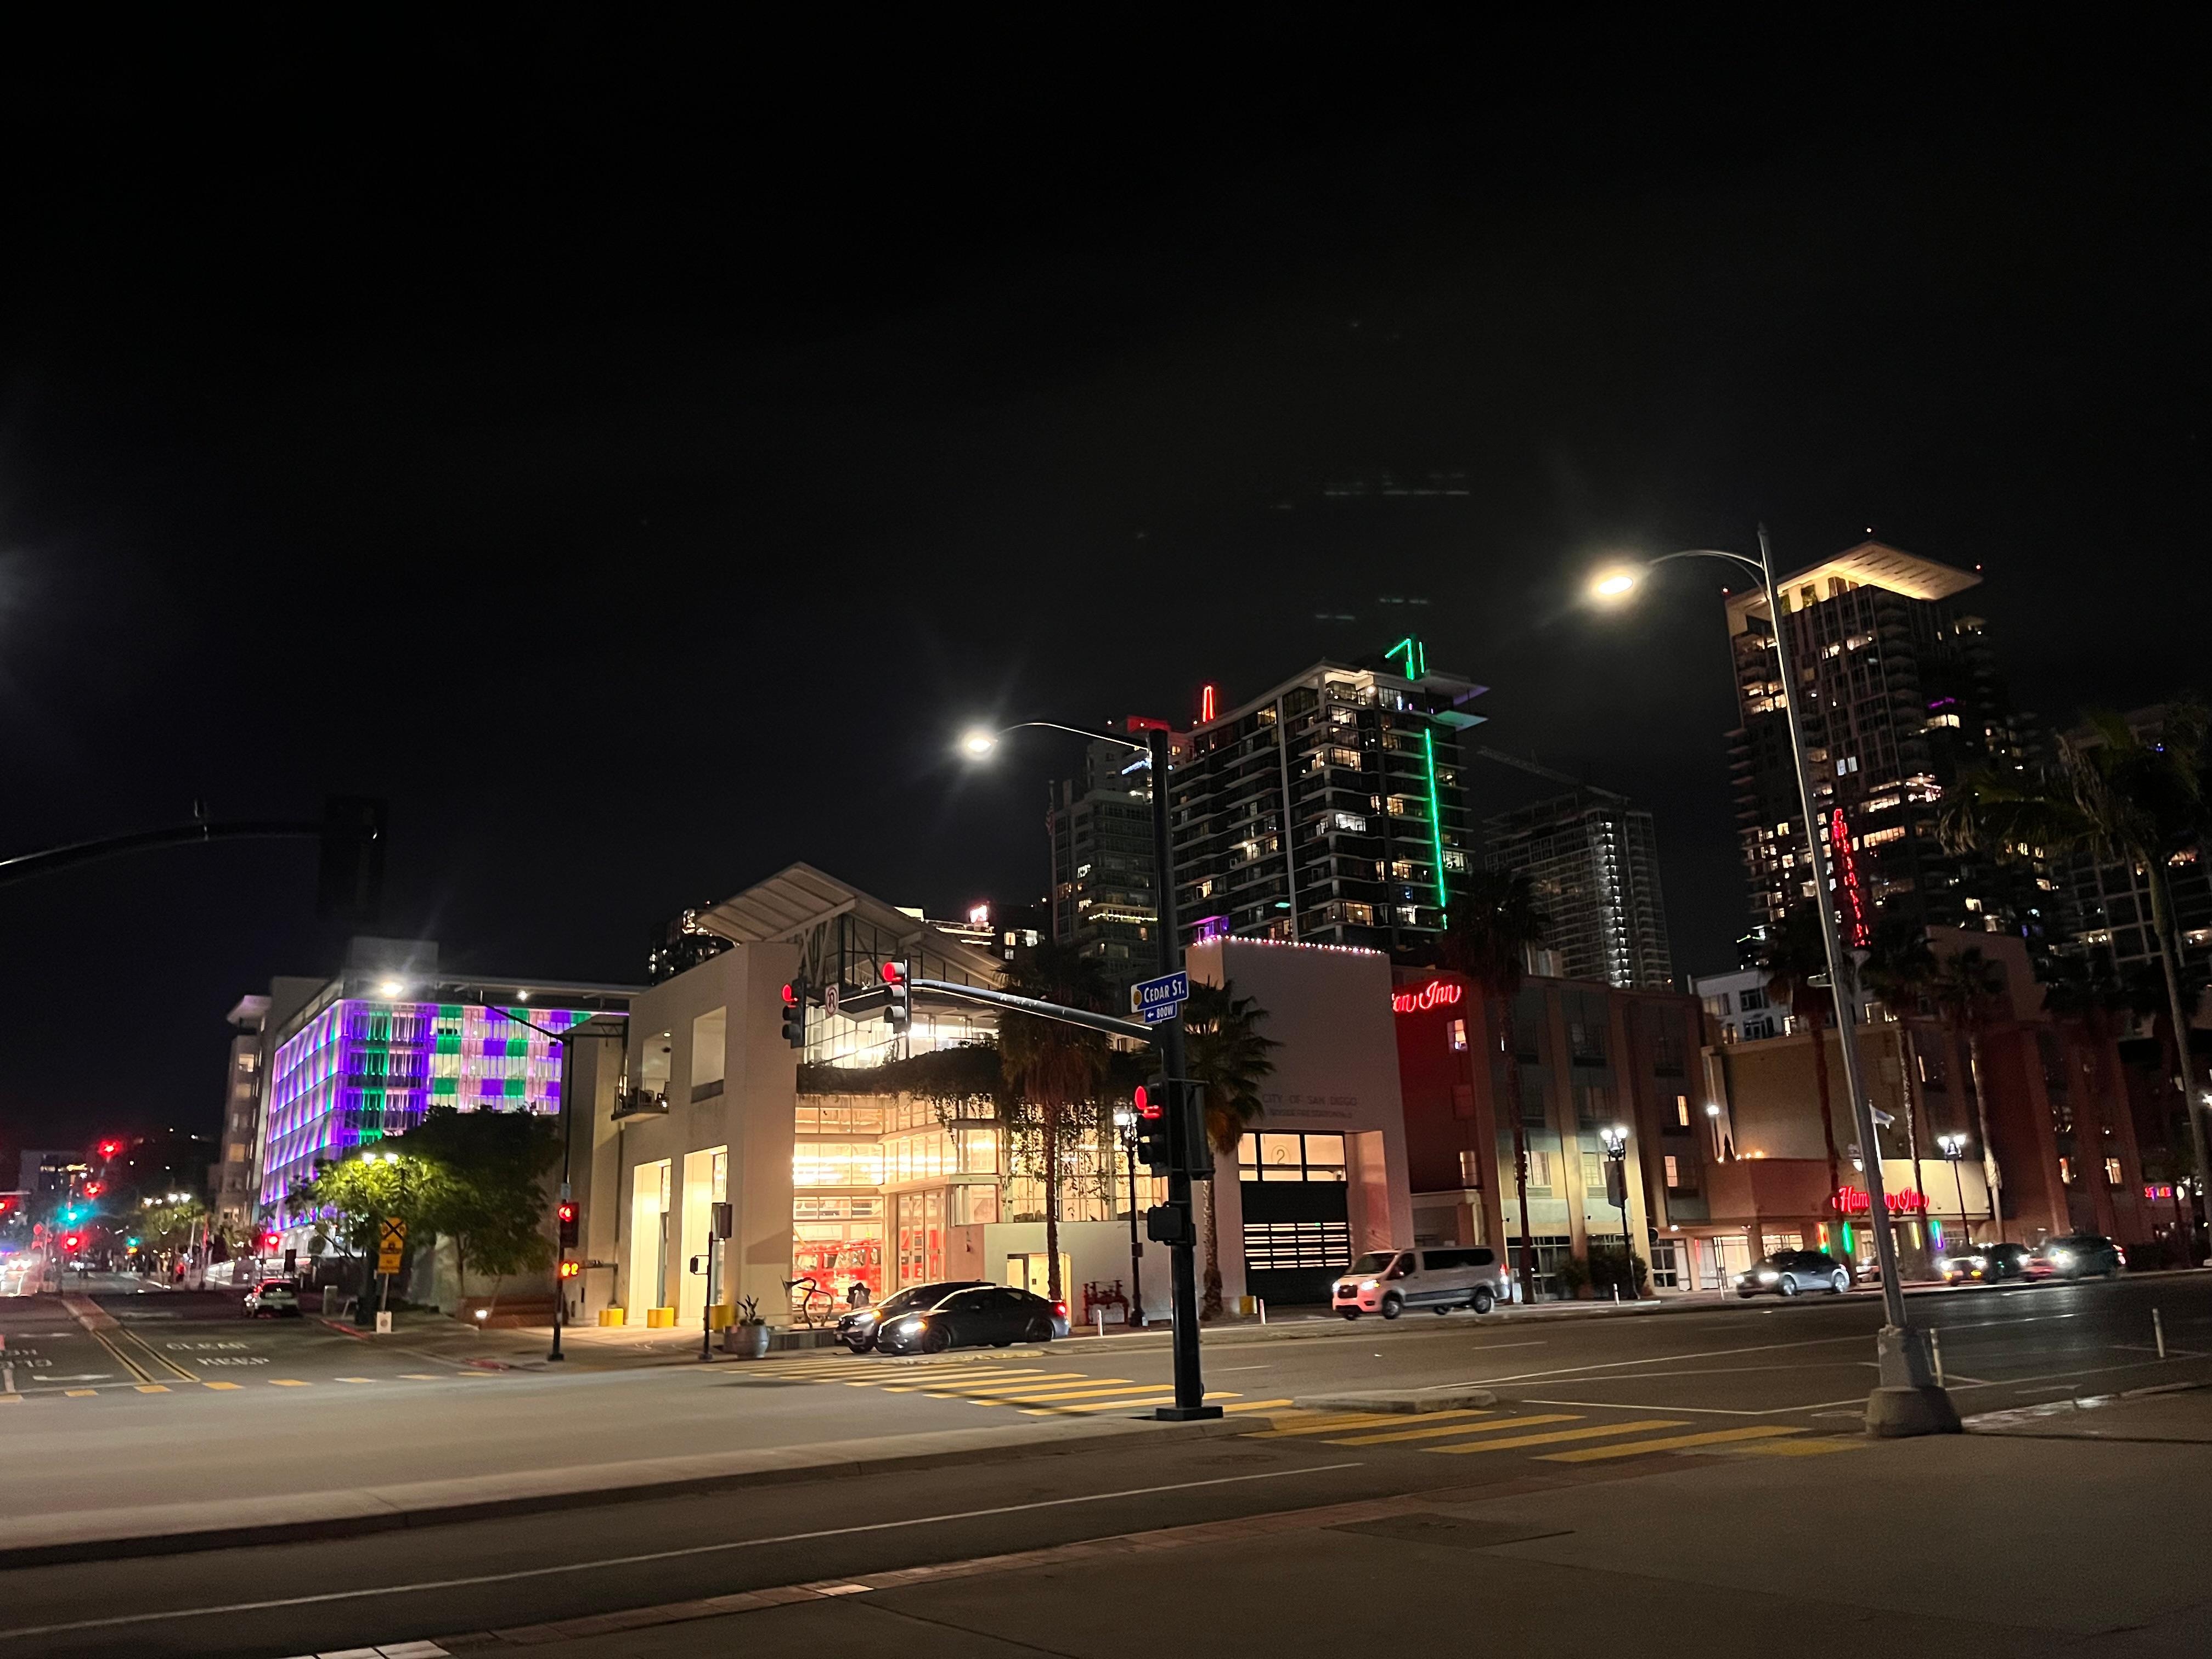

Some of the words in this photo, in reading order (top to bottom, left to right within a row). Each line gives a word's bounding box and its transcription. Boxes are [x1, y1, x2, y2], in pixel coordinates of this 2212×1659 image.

[1144, 985, 1170, 1003] CEDAR
[1172, 979, 1184, 996] ST.
[1392, 994, 1416, 1012] on
[1419, 981, 1462, 1009] Inn
[1156, 1005, 1173, 1018] 800W
[1262, 1094, 1282, 1103] CITY
[1289, 1094, 1300, 1103] OF
[1307, 1096, 1325, 1104] SAN
[1330, 1096, 1357, 1105] DIEGO
[1277, 1149, 1285, 1165] 2
